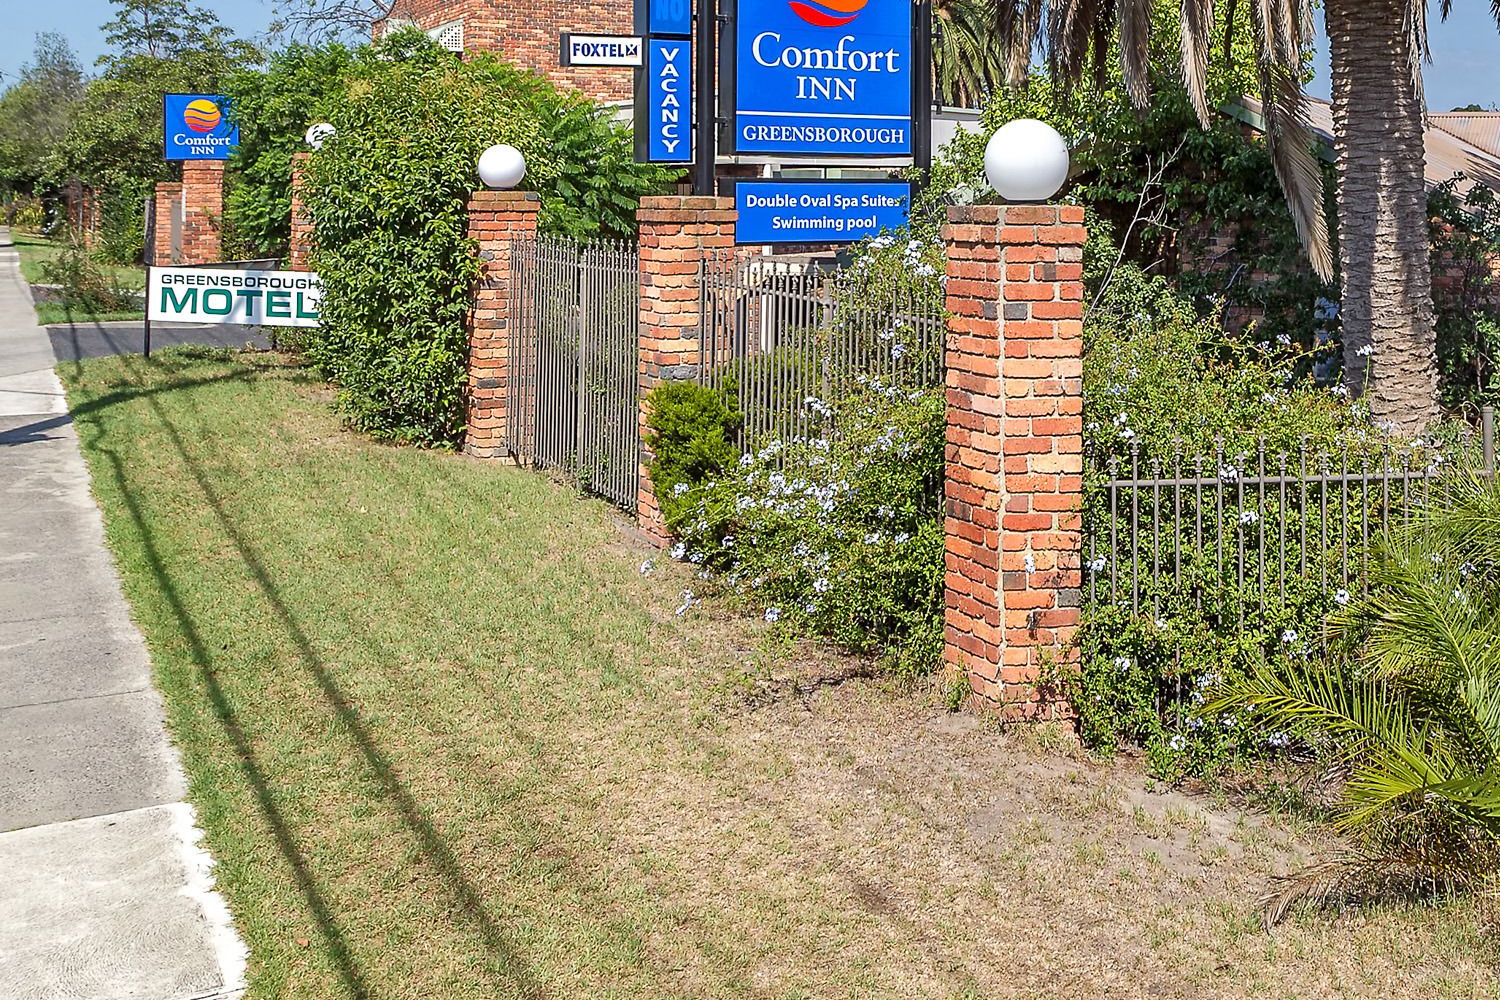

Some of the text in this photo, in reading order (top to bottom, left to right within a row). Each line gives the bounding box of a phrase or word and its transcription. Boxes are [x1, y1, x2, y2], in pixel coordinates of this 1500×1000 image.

[572, 43, 625, 57] FOXTEL
[752, 32, 900, 73] Comfort
[796, 76, 857, 101] INN
[660, 47, 680, 153] VACANCY
[173, 132, 231, 147] Comfort
[743, 125, 905, 144] GREENSBOROUGH
[191, 146, 215, 155] INN
[746, 194, 900, 210] Double Oval Spa Suites
[772, 215, 877, 231] Swimming pool
[160, 287, 319, 319] MOTEL
